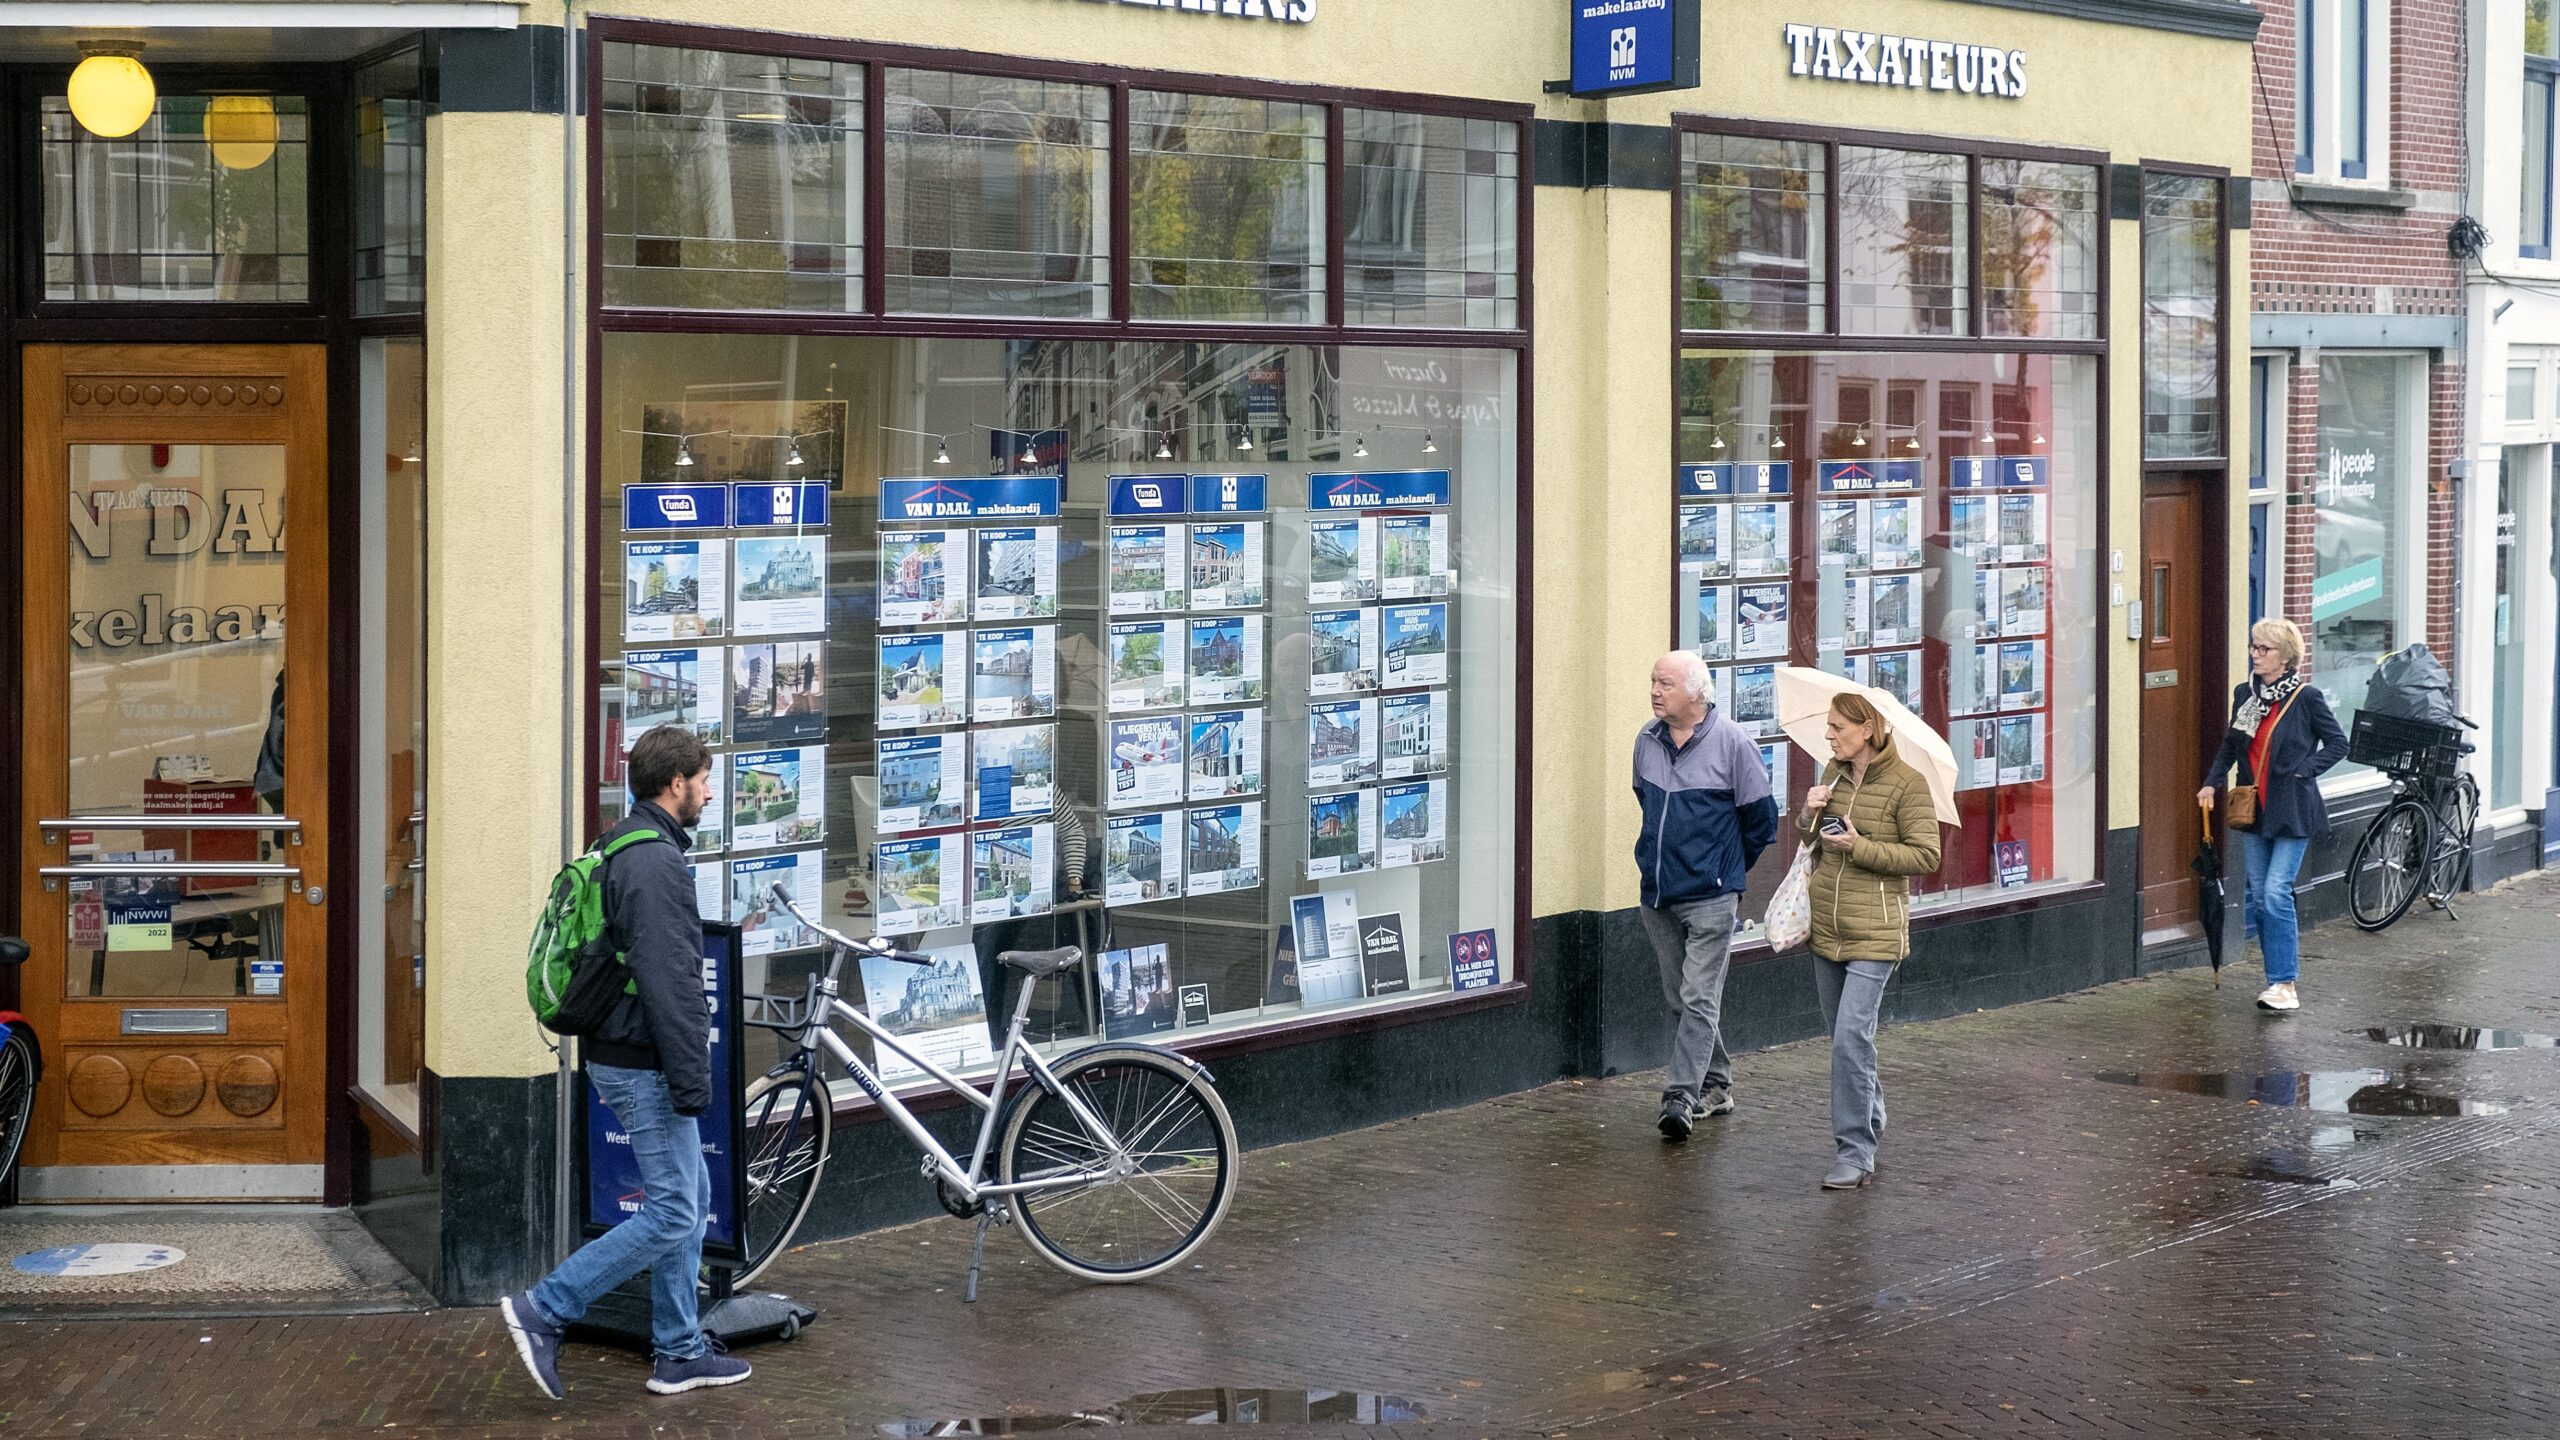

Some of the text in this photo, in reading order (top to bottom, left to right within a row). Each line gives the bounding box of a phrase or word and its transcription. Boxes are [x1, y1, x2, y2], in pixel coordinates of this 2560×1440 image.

[1786, 22, 2027, 98] TAXATEURS
[1609, 67, 1635, 81] NVM
[2341, 447, 2375, 480] people
[1832, 479, 1850, 489] VAN
[1851, 479, 1873, 489] DAAL
[1137, 487, 1157, 498] funda
[665, 499, 690, 511] funda
[1328, 494, 1436, 507] VAN DAAL makelaardij
[905, 502, 1041, 516] VAN DAAL makelaardij
[1222, 503, 1237, 511] NVM
[773, 516, 793, 524] NVM
[1193, 526, 1202, 534] TE
[1320, 522, 1335, 530] KOOP
[981, 531, 1007, 540] TE KOOP
[1121, 528, 1137, 536] KOOP
[895, 534, 913, 542] KOOP
[631, 546, 641, 554] TE
[643, 545, 664, 554] KOOP
[1201, 620, 1217, 628] KOOP
[1111, 625, 1137, 634] TE KOOP
[987, 632, 1005, 640] KOOP
[882, 637, 911, 646] TE KOOP
[628, 653, 661, 662] TE KOOP
[1201, 715, 1217, 723] KOOP
[1117, 721, 1172, 735] VLIEGENSVLUG
[882, 741, 911, 750] TE KOOP
[737, 755, 767, 765] TE KOOP
[174, 791, 235, 802] openingstijden
[1311, 798, 1319, 806] TE
[1192, 810, 1216, 820] TE KOOP
[1109, 818, 1135, 828] TE KOOP
[975, 832, 1003, 842] TE KOOP
[881, 844, 909, 854] TE KOOP
[735, 861, 766, 873] TE KOOP
[128, 910, 168, 920] NWWI
[75, 932, 100, 940] MVA
[147, 929, 168, 937] 2022
[1366, 935, 1398, 948] VAN DAAL
[848, 1061, 881, 1099] UNION
[605, 1131, 631, 1145] Weet
[619, 1201, 639, 1212] VAN
